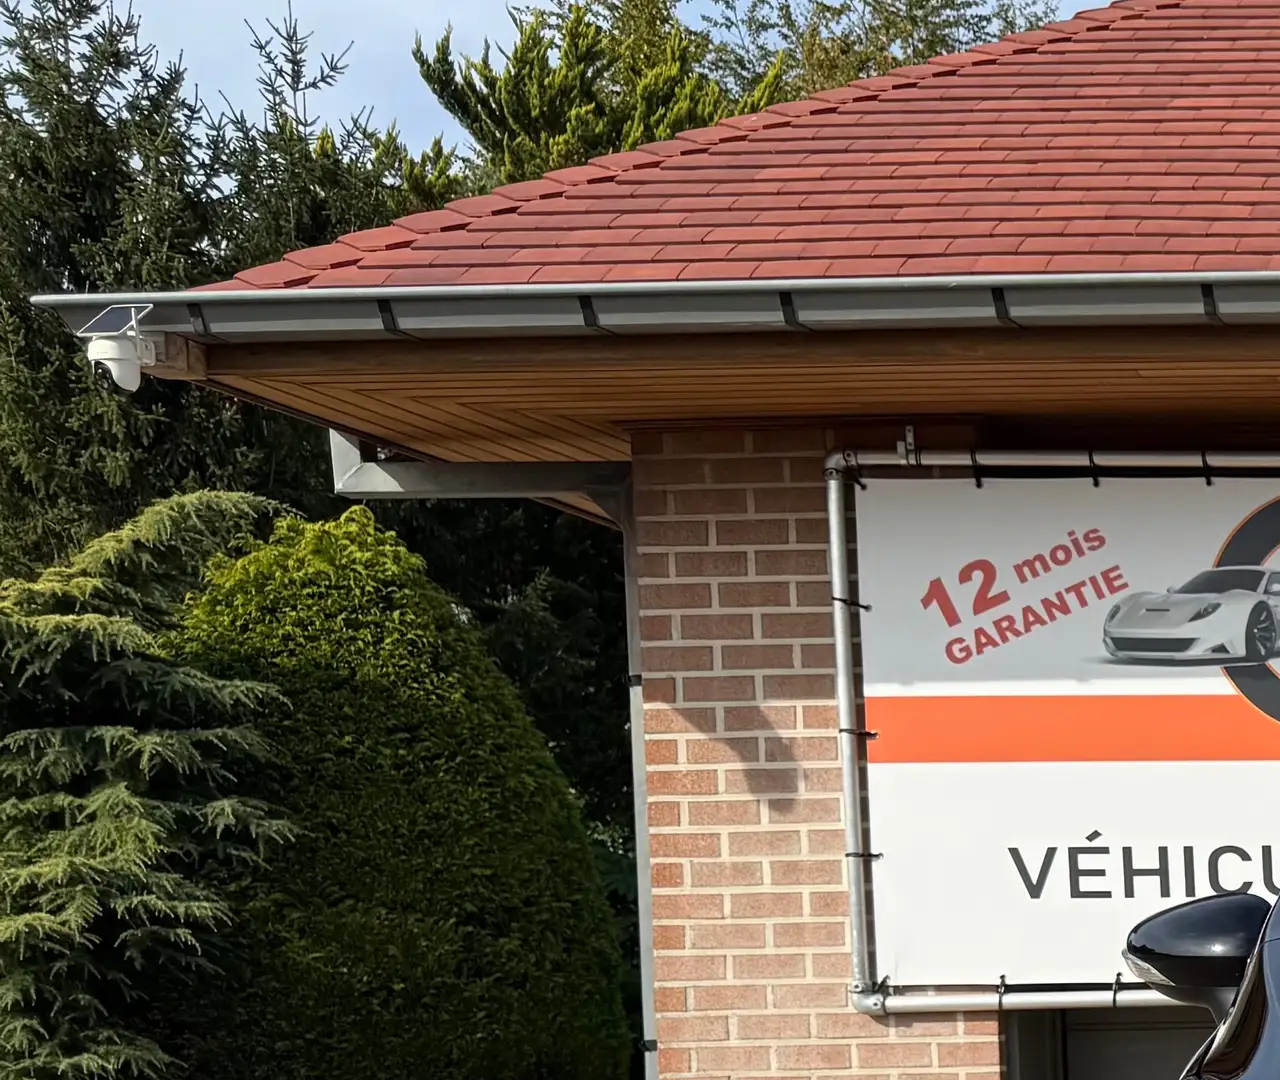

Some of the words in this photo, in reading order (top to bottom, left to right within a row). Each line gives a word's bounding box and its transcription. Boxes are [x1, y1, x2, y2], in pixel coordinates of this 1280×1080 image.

[920, 558, 1011, 628] 12
[1012, 527, 1107, 584] mois
[944, 564, 1129, 665] GARANTIE
